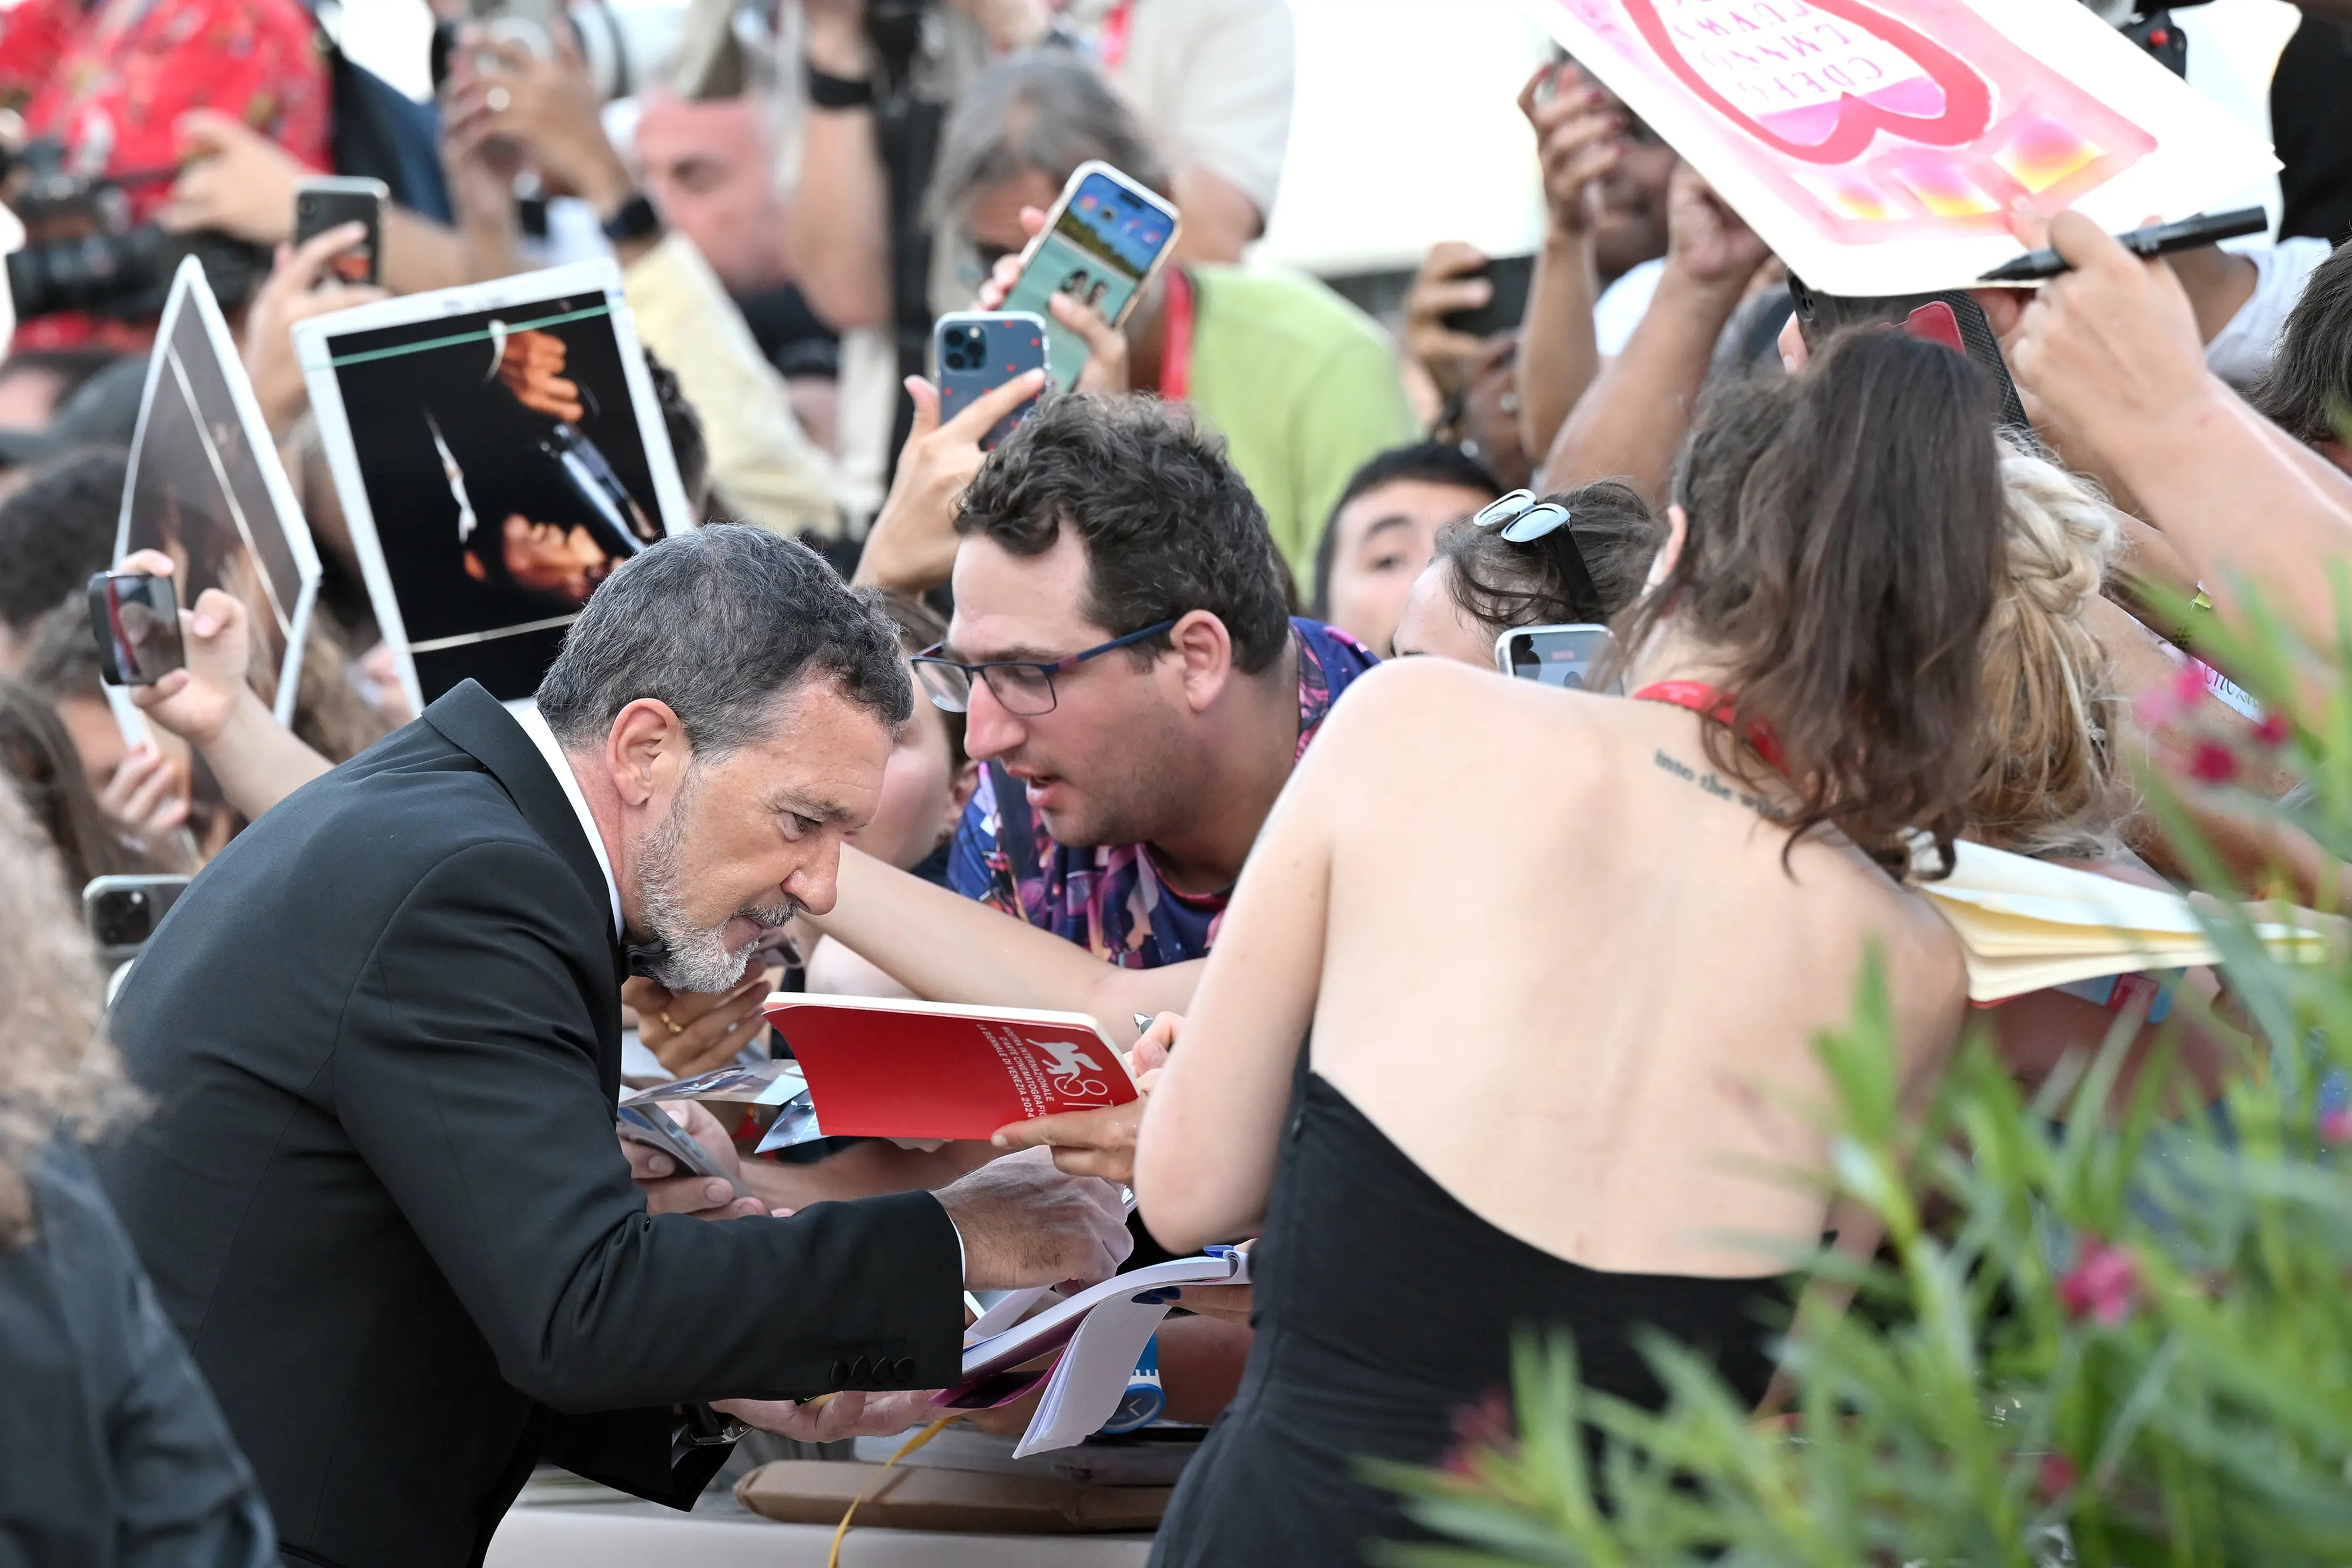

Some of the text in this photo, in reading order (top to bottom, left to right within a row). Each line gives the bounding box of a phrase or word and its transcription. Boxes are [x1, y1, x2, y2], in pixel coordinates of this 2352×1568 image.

[977, 1024, 984, 1034] LA
[983, 1031, 1007, 1058] BIENNALE
[1007, 1065, 1027, 1095] VENEZIA
[1021, 1095, 1035, 1118] 2024
[999, 1037, 1018, 1056] D'ARTE
[1001, 1025, 1054, 1102] MOSTRA INTERNAZIONALE
